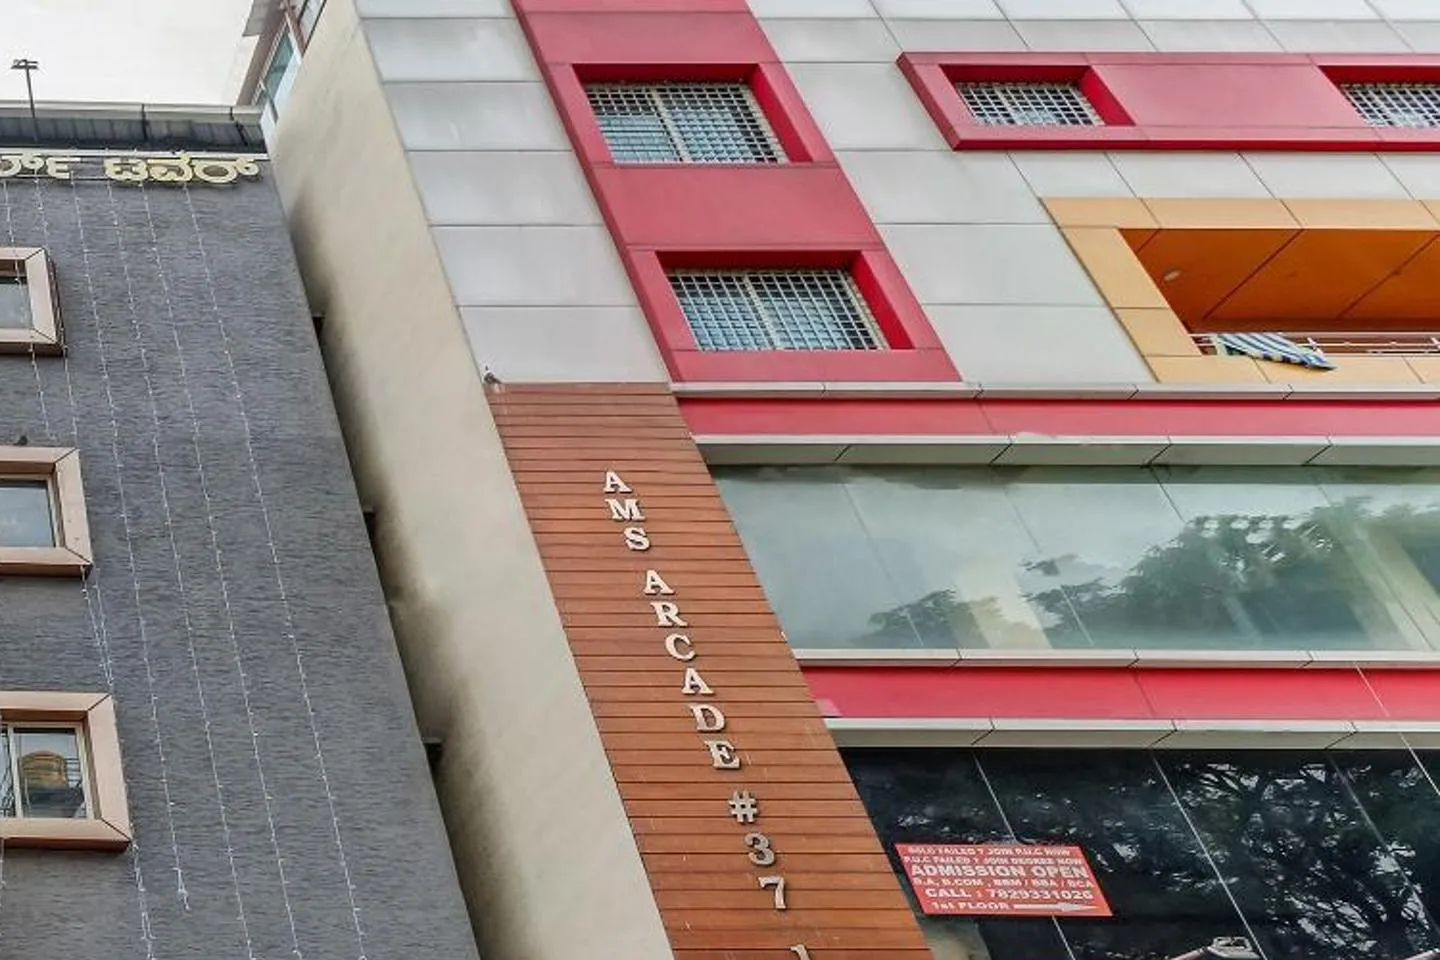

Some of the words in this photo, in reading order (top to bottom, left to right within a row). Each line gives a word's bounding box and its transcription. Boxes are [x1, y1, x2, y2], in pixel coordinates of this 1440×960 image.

[603, 470, 651, 551] AMS
[643, 569, 740, 770] ARCADE
[911, 865, 1025, 877] ADMISSION
[1032, 866, 1089, 878] OPEN
[925, 888, 972, 898] CALL
[958, 902, 1010, 910] FLOOR
